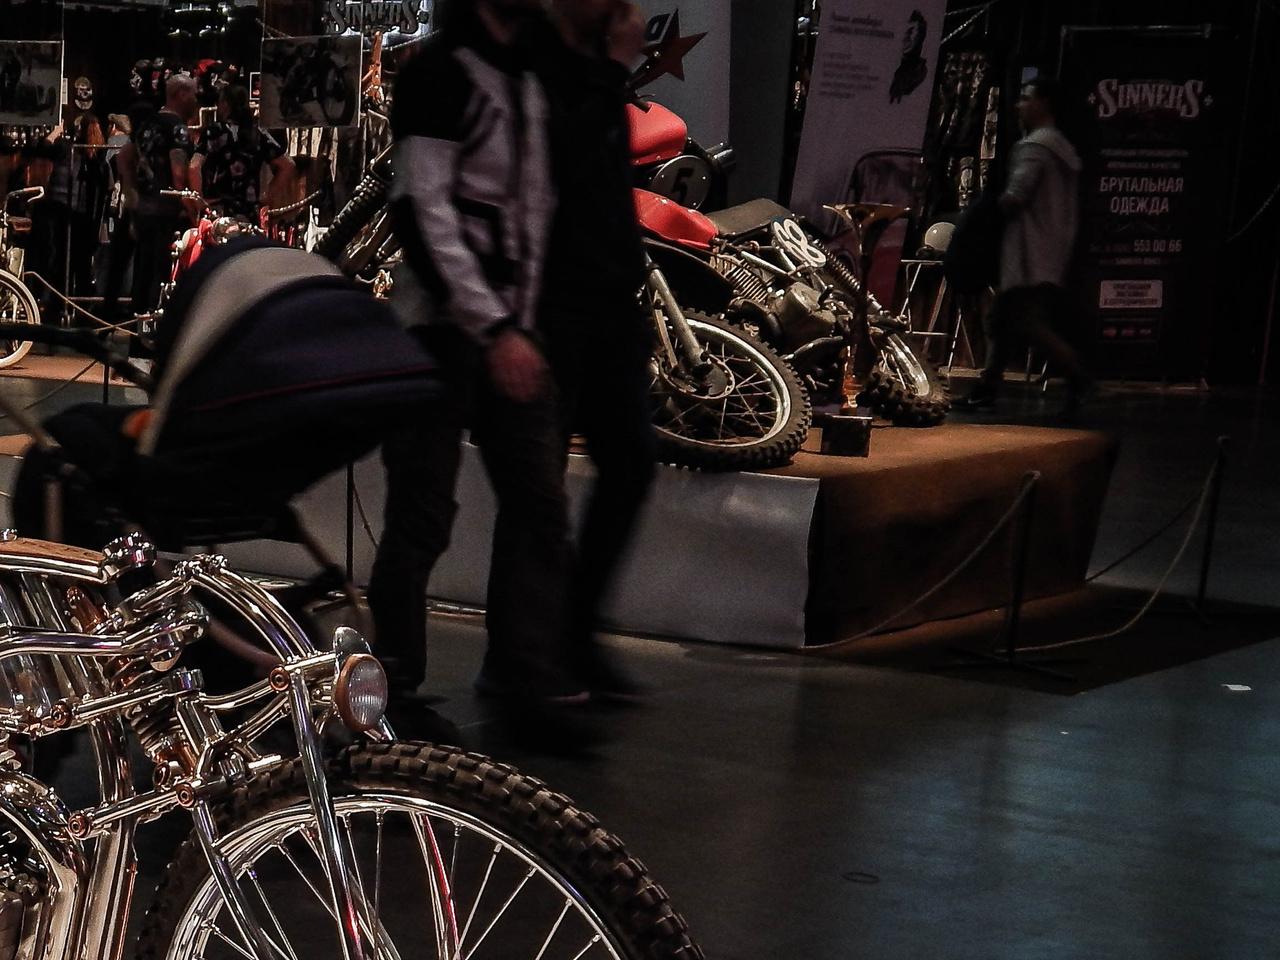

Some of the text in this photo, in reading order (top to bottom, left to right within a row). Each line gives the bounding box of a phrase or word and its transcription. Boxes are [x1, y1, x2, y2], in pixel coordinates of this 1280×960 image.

[329, 0, 418, 34] SINNERS
[1099, 79, 1203, 117] SINNERS
[672, 168, 693, 203] 5
[1100, 177, 1184, 192] БРУТАЛЬНАЯ
[1110, 197, 1169, 215] ОДЕЖДА
[773, 218, 826, 267] 68
